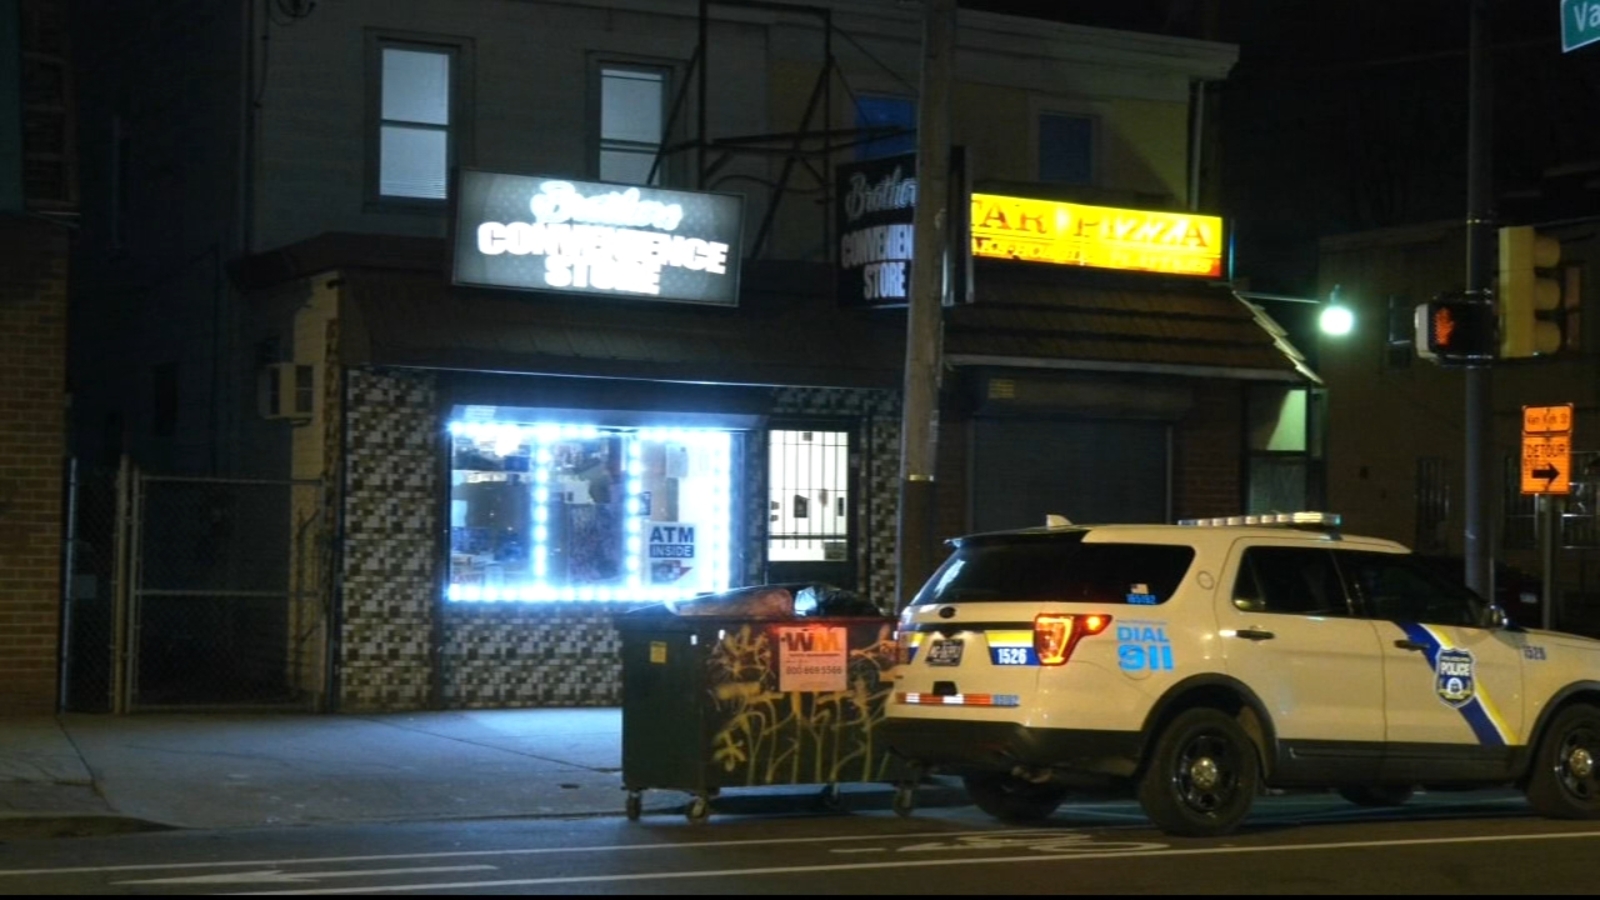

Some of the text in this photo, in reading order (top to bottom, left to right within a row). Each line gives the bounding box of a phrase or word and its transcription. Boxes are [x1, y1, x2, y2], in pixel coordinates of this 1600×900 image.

[969, 199, 1208, 248] TAR PIZZA
[477, 221, 729, 274] CONVENIENCE
[841, 224, 914, 269] CONVENIEN
[544, 254, 661, 295] STORE
[864, 262, 906, 299] STORE
[1525, 443, 1566, 459] DETOUR
[649, 526, 694, 543] ATM
[652, 545, 692, 557] INSIDE
[785, 631, 839, 652] WM
[1117, 626, 1170, 642] DIAL
[997, 648, 1027, 664] 1526
[1117, 643, 1174, 671] 911
[1440, 662, 1471, 676] POLICE
